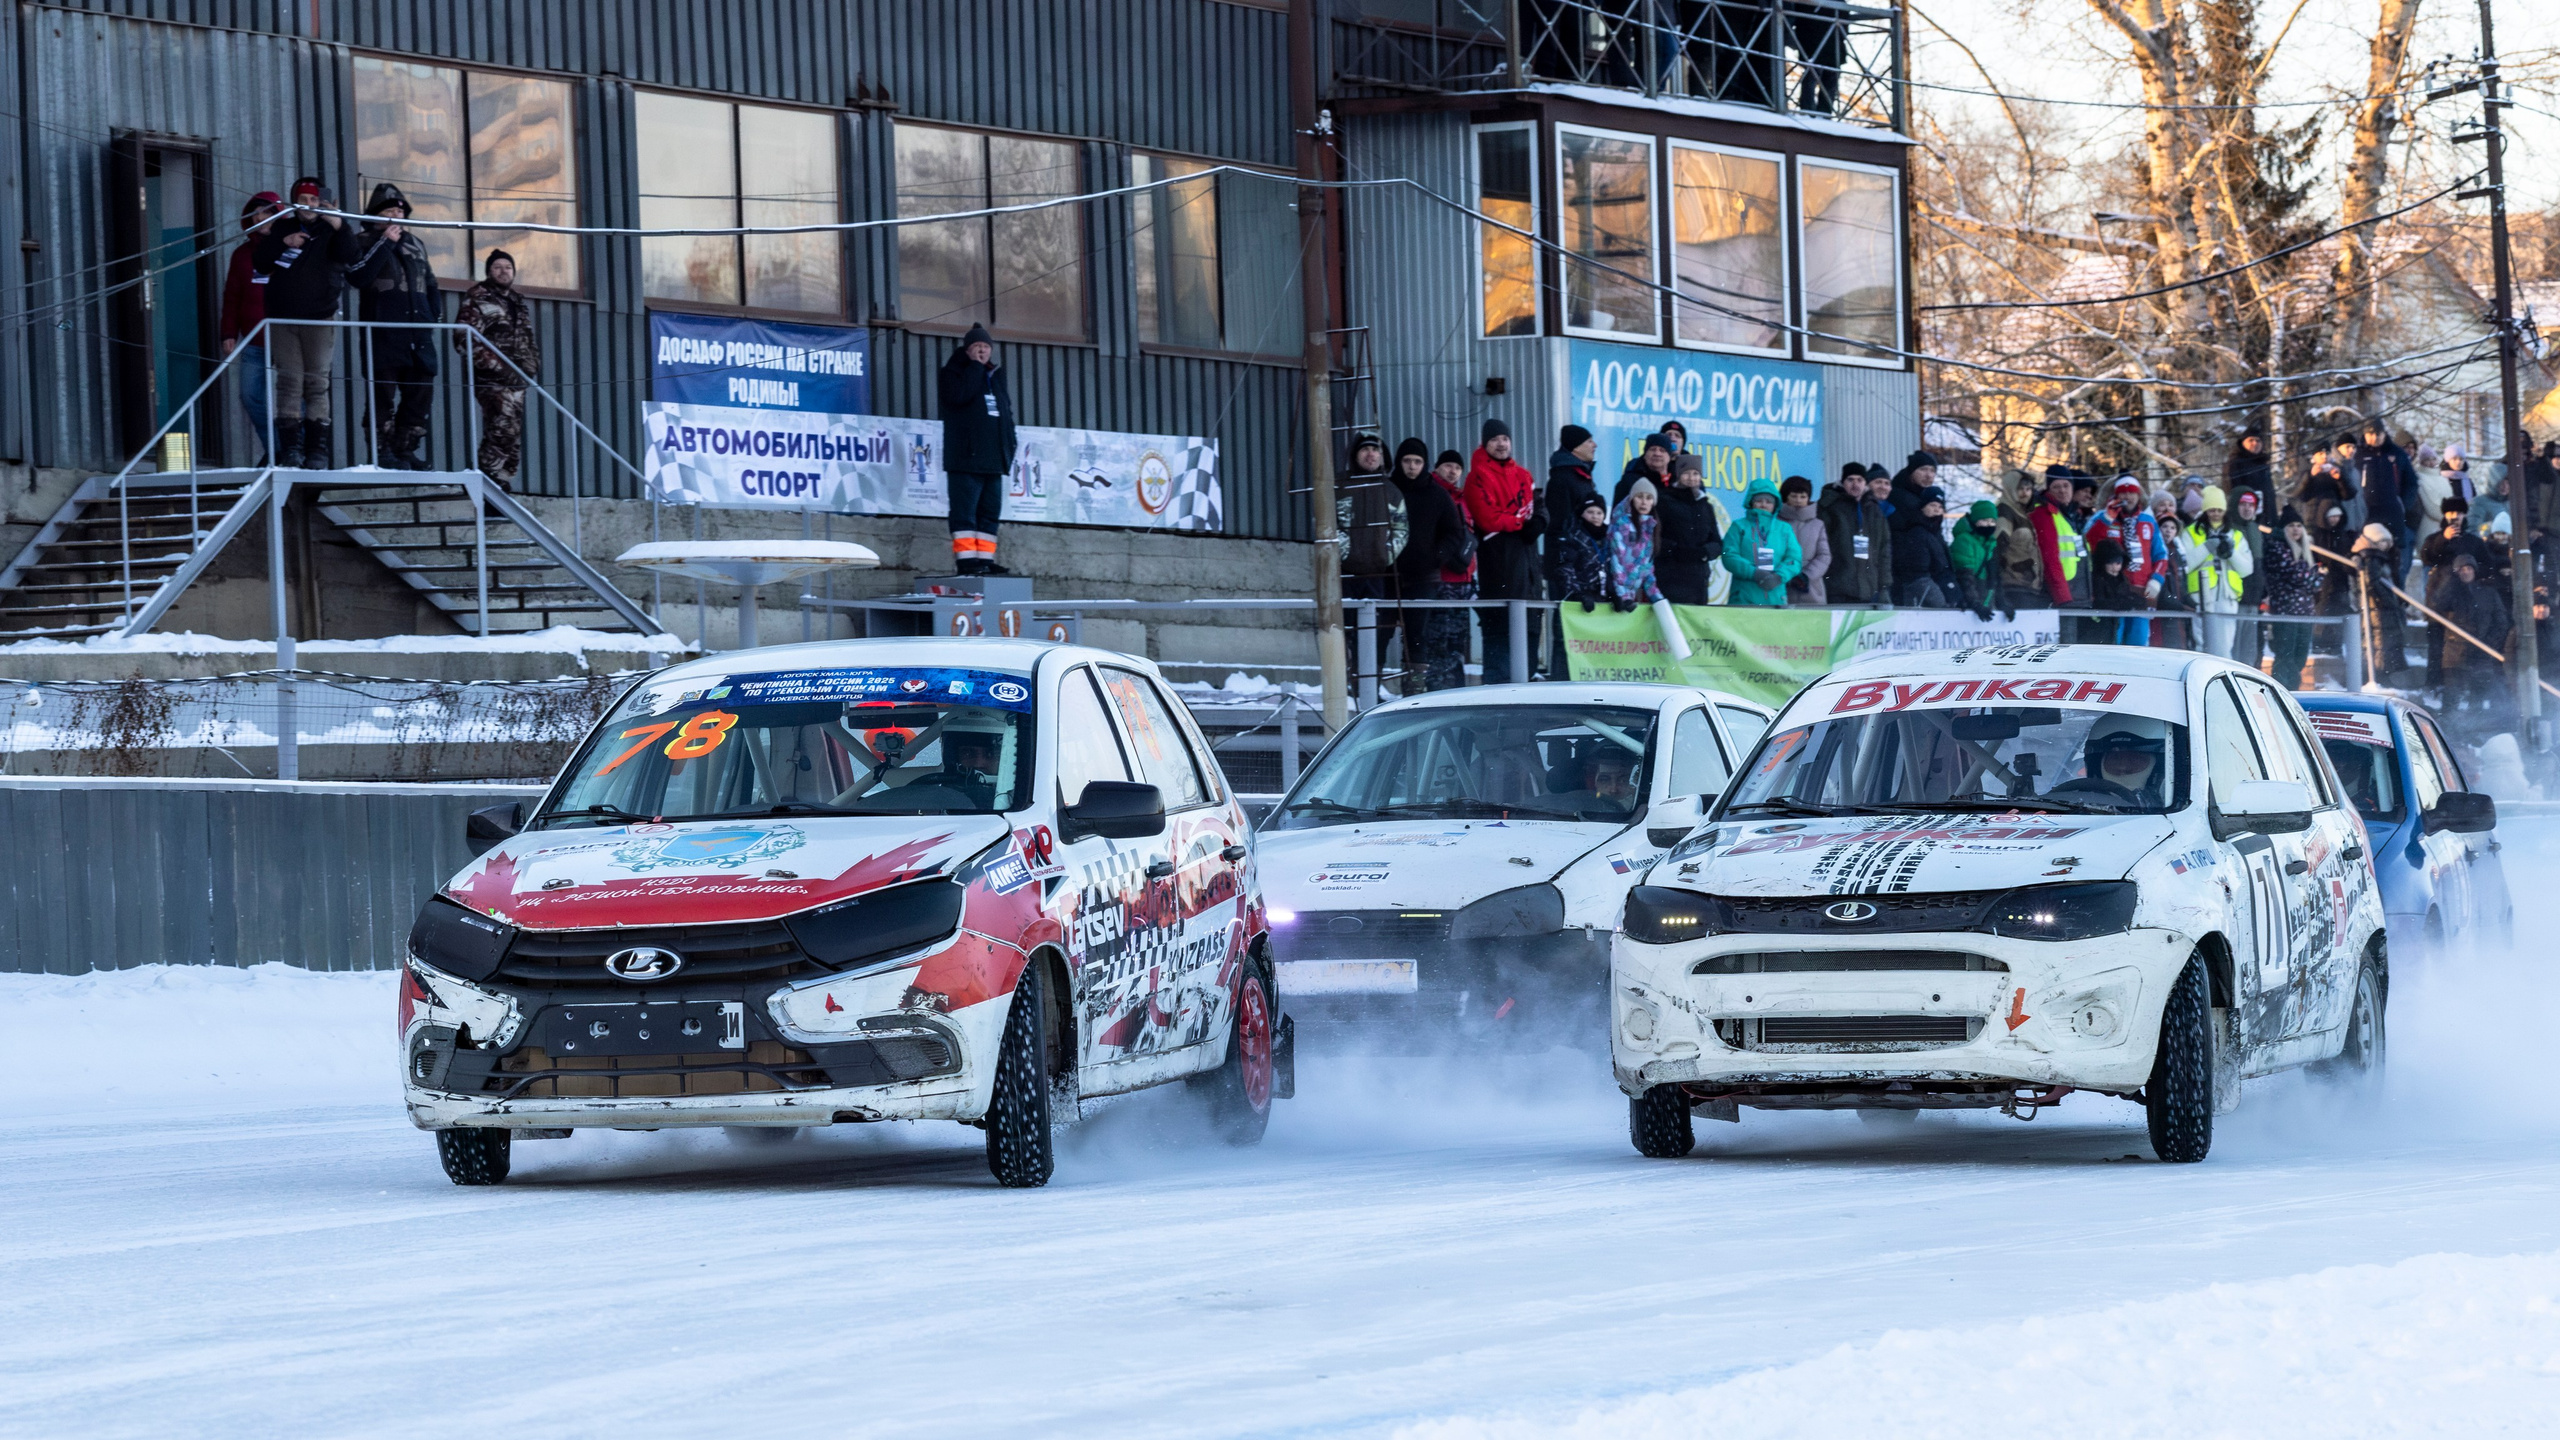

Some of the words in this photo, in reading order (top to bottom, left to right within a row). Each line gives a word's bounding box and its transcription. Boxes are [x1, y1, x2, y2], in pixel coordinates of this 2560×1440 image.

[658, 336, 724, 366] ДОСААФ
[726, 341, 784, 372] РОССИИ
[786, 346, 805, 373] НА
[808, 349, 864, 377] СТРАЖЕ
[729, 377, 800, 407] РОДИНЫ!
[1582, 359, 1704, 425] ДОСААФ
[1710, 372, 1818, 425] РОССИИ
[663, 426, 891, 464] АВТОМОБИЛЬНЫЙ
[741, 469, 822, 498] СПОРТ
[1858, 631, 1937, 650] АПАРТАМЕНТЫ
[1942, 630, 2025, 649] ПОСУТОЧНО
[740, 679, 812, 690] ЧЕМПИОНАТ
[744, 688, 761, 696] ПО
[766, 686, 833, 695] ТРЕКОВЫМ
[835, 684, 888, 692] ГОНКАМ
[1830, 678, 2126, 715] Вулкан
[594, 709, 739, 777] 78
[1329, 872, 1390, 880] eurol
[550, 885, 808, 903] «РЕГИОН-ОБРАЗОВАНИЕ»
